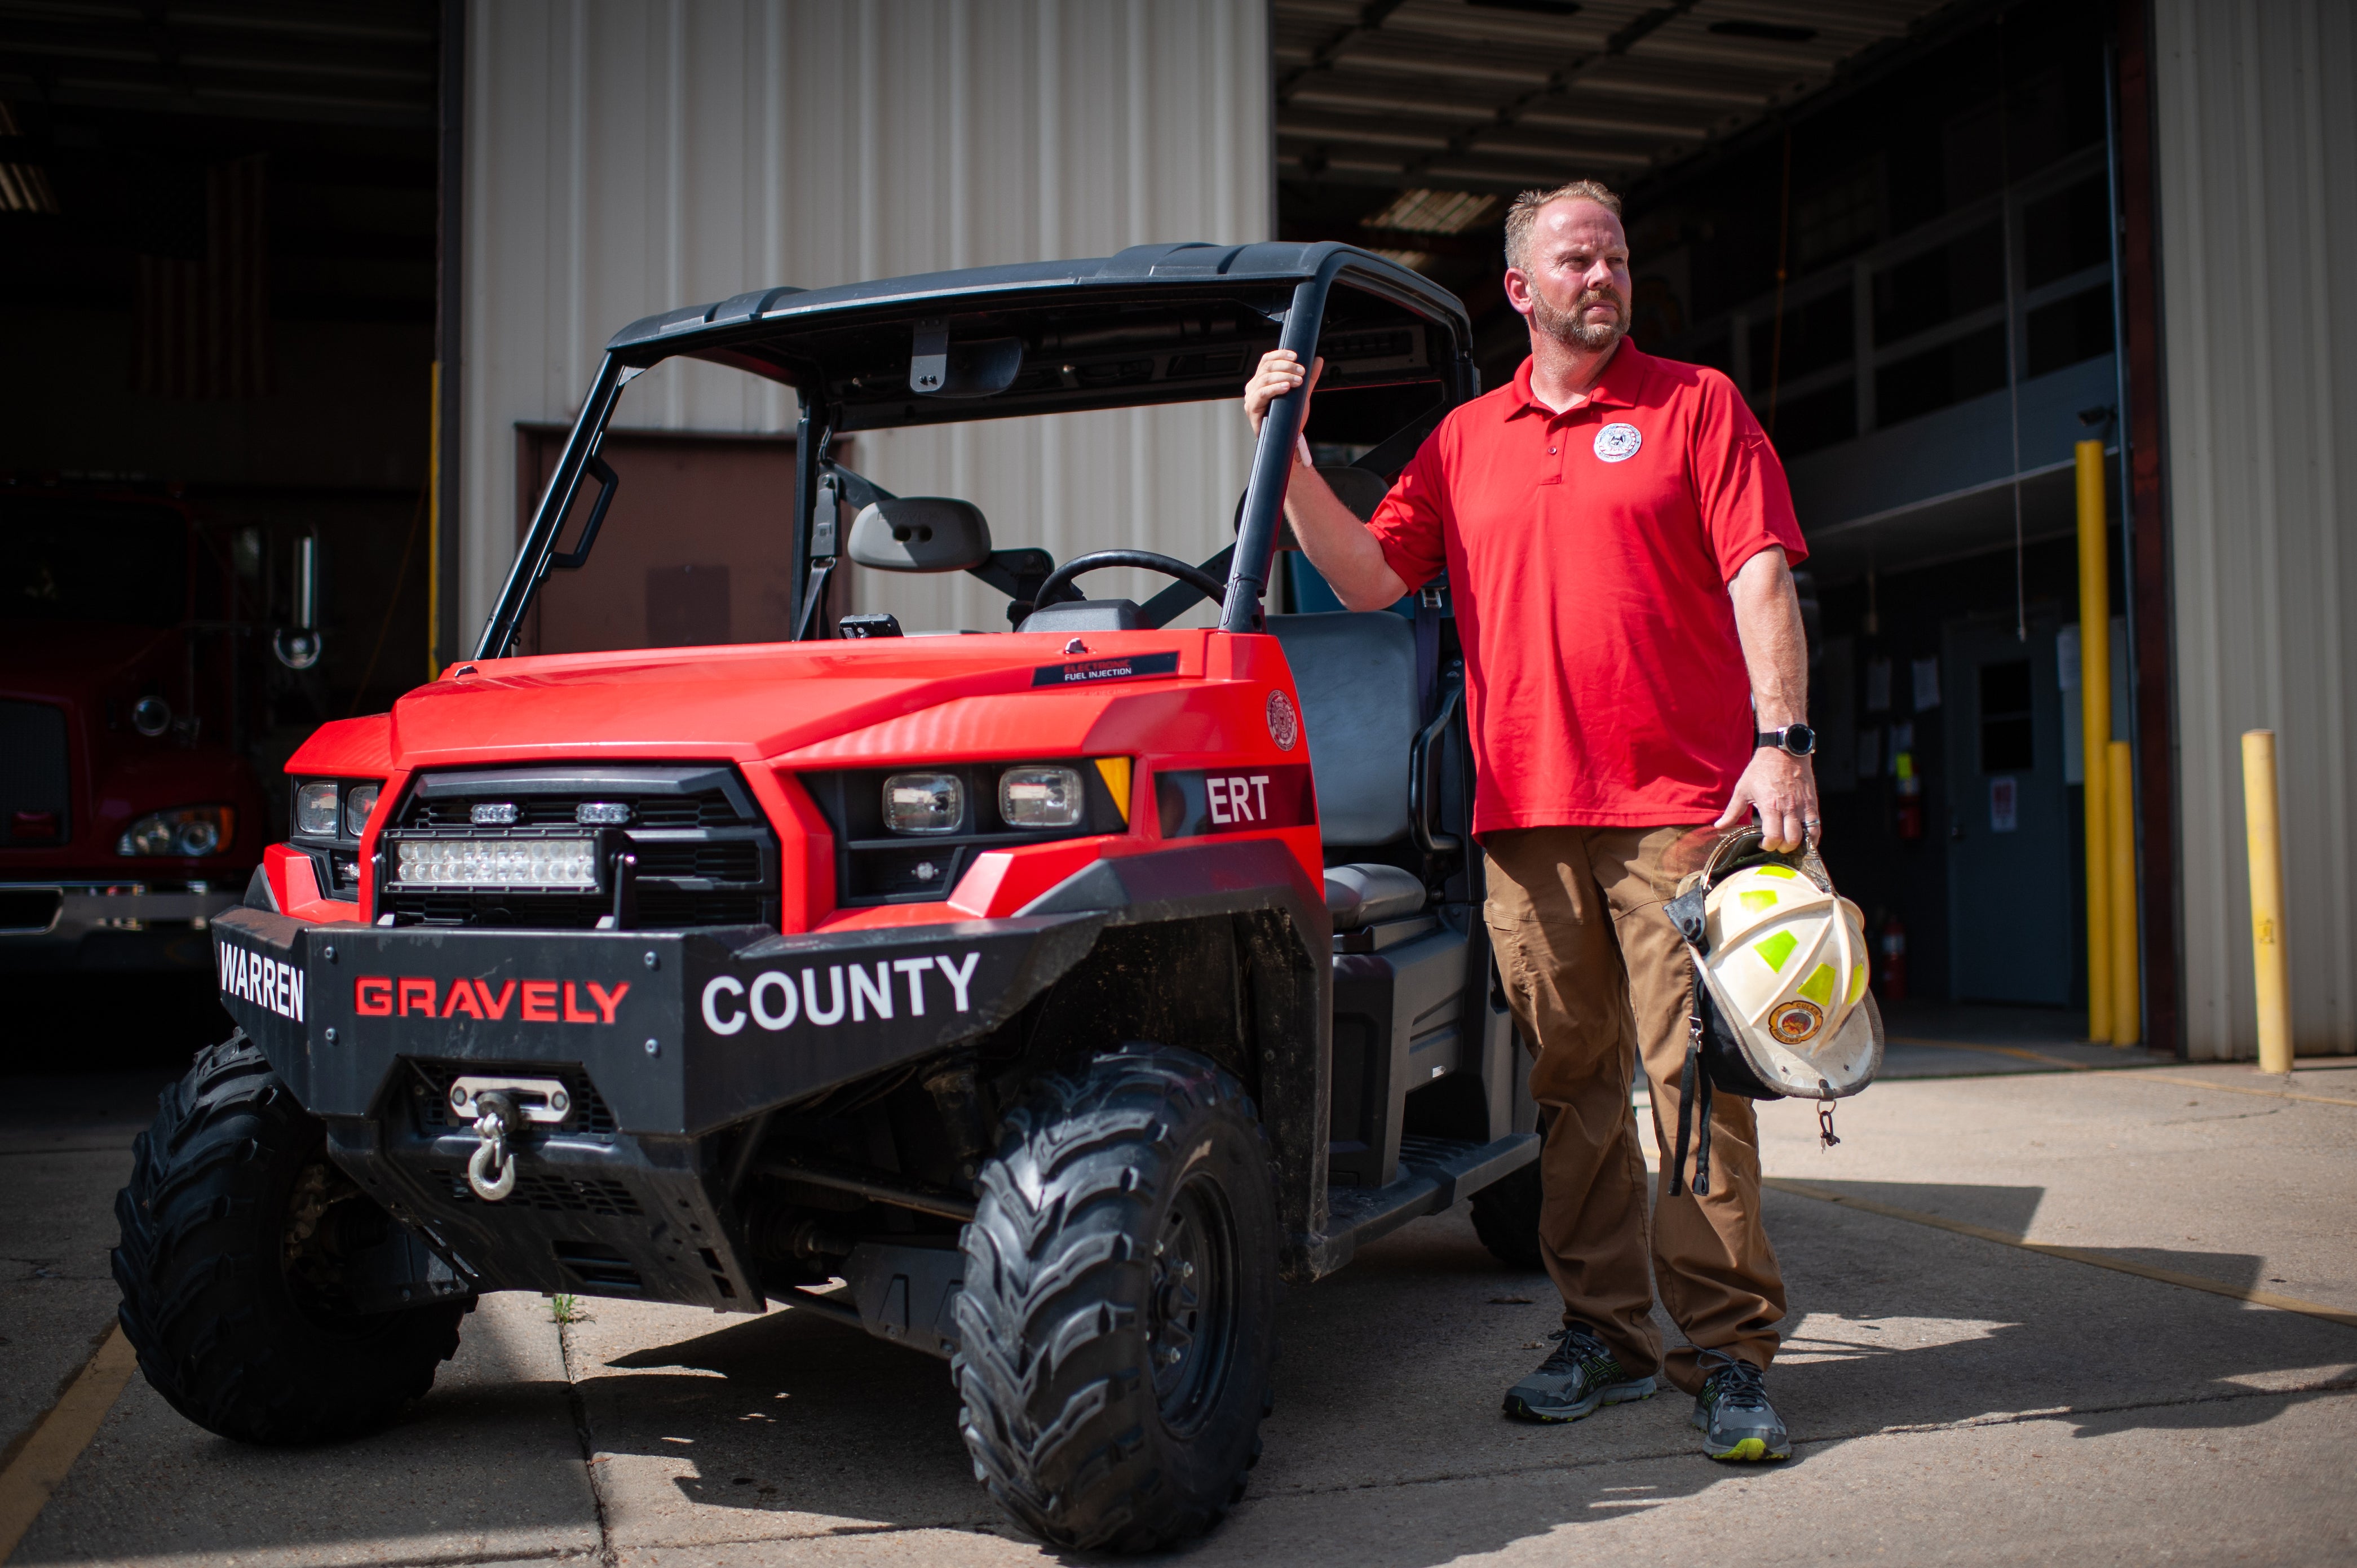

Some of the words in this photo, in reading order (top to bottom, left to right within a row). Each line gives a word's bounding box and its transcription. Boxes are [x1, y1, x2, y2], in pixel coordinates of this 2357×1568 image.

[1064, 672, 1087, 681] FUEL
[1089, 667, 1132, 679] INJECTION
[1206, 775, 1270, 825] ERT
[220, 941, 304, 1022] WARREN
[354, 975, 631, 1024] GRAVELY
[701, 952, 980, 1035] COUNTY
[1796, 1003, 1819, 1016] CULKIN
